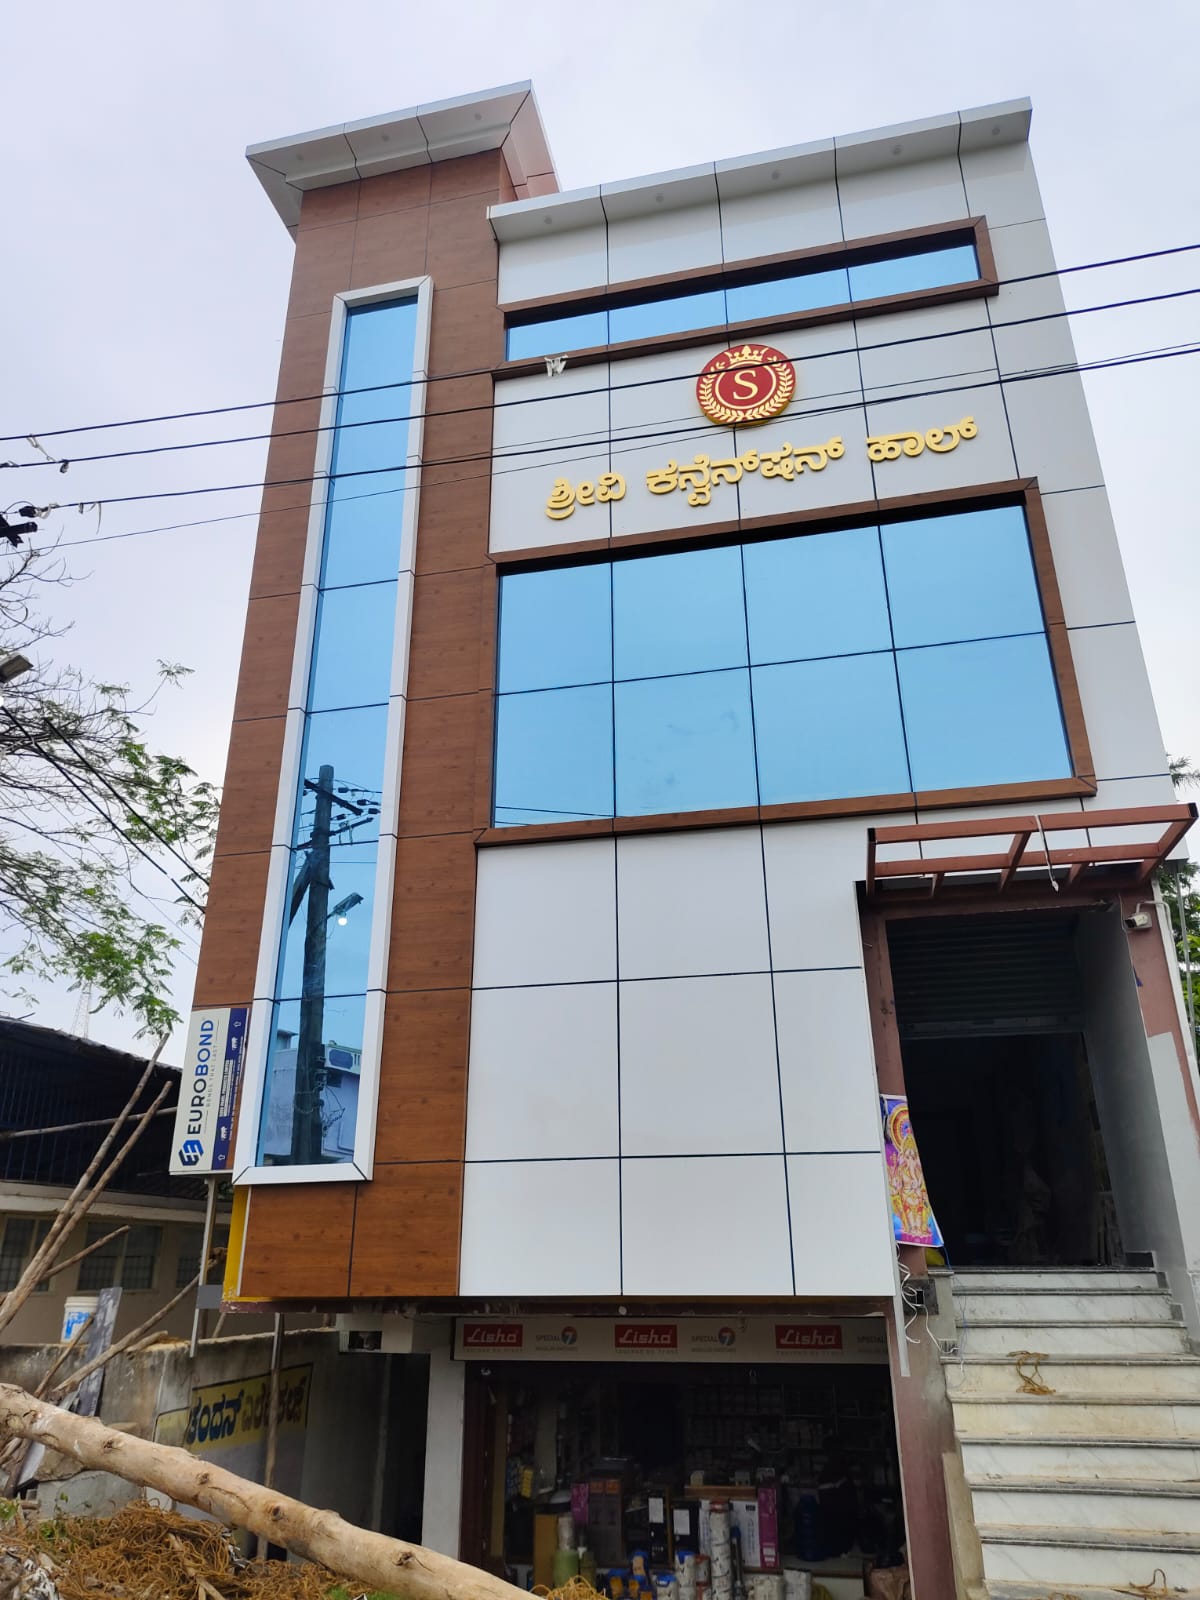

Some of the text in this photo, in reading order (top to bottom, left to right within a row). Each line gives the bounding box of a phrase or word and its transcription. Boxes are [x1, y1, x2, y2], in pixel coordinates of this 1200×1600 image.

[732, 369, 759, 400] S
[866, 416, 978, 462] ಹಾಲ್
[187, 1019, 215, 1135] EUROBOND
[467, 1328, 517, 1343] Lisha
[618, 1329, 672, 1344] Lisha
[780, 1329, 836, 1345] Lisha
